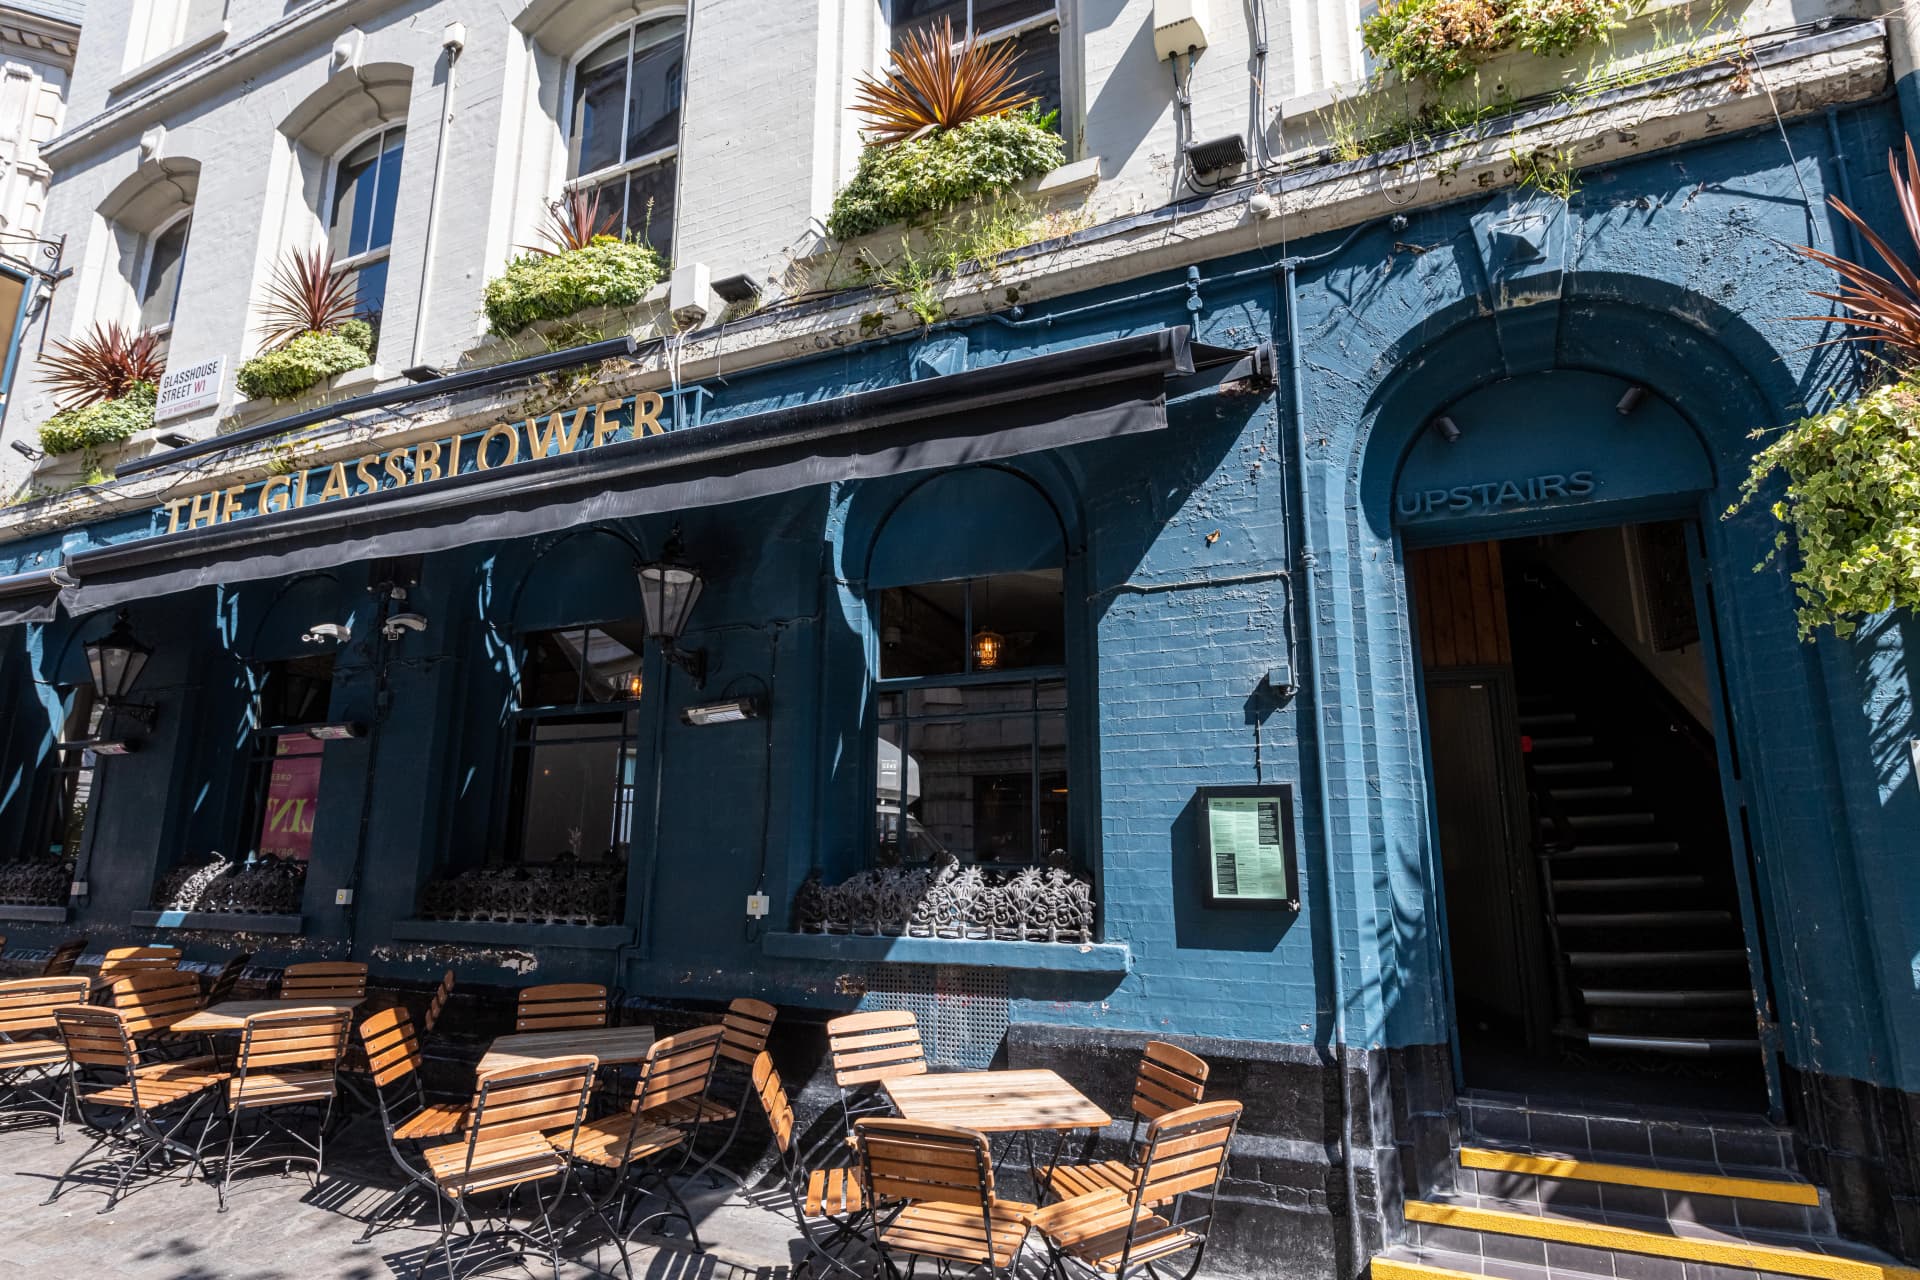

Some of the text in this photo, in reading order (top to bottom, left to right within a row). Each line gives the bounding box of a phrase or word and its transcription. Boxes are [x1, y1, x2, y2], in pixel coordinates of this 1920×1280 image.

[161, 379, 206, 404] STREET W1
[163, 361, 218, 389] GLASSHOUSE
[164, 485, 246, 534] THE
[1398, 471, 1596, 516] UPSTAIRS
